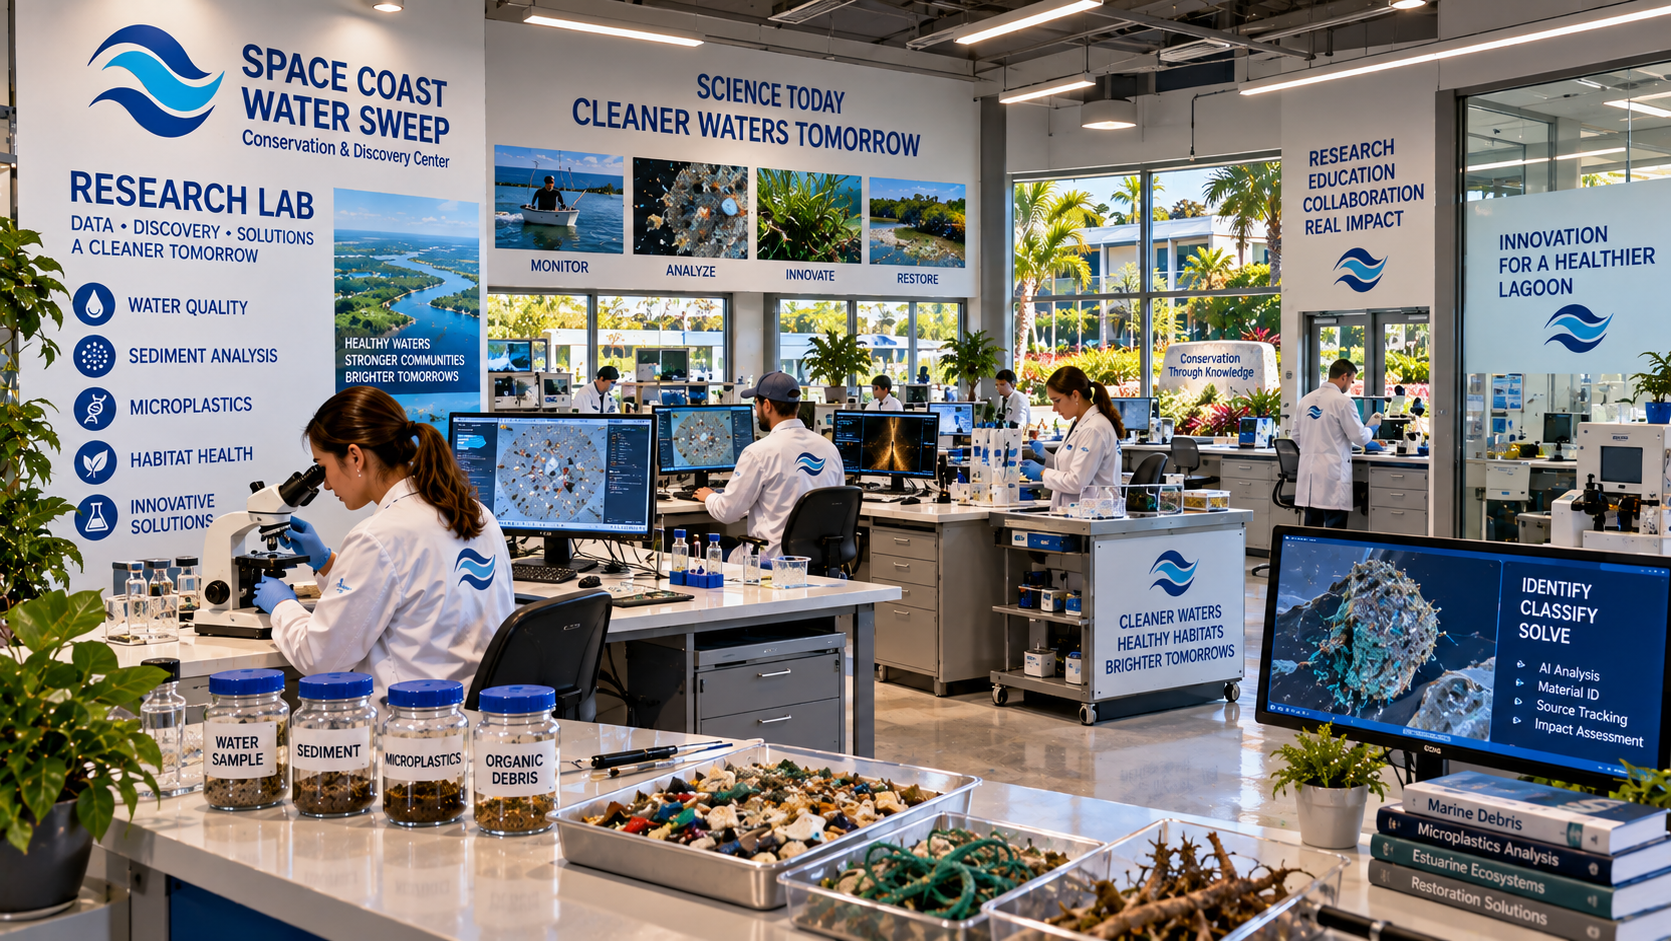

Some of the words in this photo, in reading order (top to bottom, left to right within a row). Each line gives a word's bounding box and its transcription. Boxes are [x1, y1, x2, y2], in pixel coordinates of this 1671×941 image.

[242, 43, 348, 92] SPACE
[357, 65, 447, 108] COAST
[697, 73, 781, 108] SCIENCE
[786, 83, 845, 115] TODAY
[242, 86, 350, 133] WATER
[359, 105, 449, 145] SWEEP
[572, 97, 690, 135] CLEANER
[697, 110, 789, 145] WATERS
[795, 121, 920, 157] TOMORROW
[242, 129, 336, 156] Conservation
[340, 142, 350, 157] &
[354, 144, 410, 167] Discovery
[413, 151, 450, 169] Center
[1309, 138, 1395, 167] RESEARCH
[1308, 163, 1396, 190] EDUCATION
[70, 170, 247, 216] RESEARCH
[259, 188, 314, 220] LAB
[1303, 183, 1425, 213] COLLABORATION
[71, 215, 114, 234] DATA
[134, 220, 221, 240] DISCOVERY
[237, 226, 314, 246] SOLUTIONS
[1305, 216, 1341, 235] REAL
[1346, 210, 1404, 232] IMPACT
[1499, 226, 1608, 251] INNOVATION
[71, 239, 83, 254] A
[89, 240, 164, 260] CLEANER
[169, 244, 259, 263] TOMORROW
[1499, 256, 1531, 274] FOR
[1536, 255, 1549, 271] A
[1555, 247, 1655, 270] HEALTHIER
[531, 258, 589, 274] MONITOR
[665, 263, 716, 278] ANALYZE
[786, 268, 835, 281] INNOVATE
[897, 272, 939, 285] RESTORE
[1499, 278, 1573, 298] LAGOON
[128, 297, 181, 314] WATER
[185, 298, 248, 316] QUALITY
[344, 337, 389, 350] HEALTHY
[392, 338, 431, 350] WATERS
[129, 348, 207, 364] SEDIMENT
[211, 348, 278, 363] ANALYSIS
[344, 354, 398, 367] STRONGER
[401, 354, 465, 366] COMMUNITIES
[1180, 353, 1240, 364] Conservation
[345, 369, 395, 383] BRIGHTER
[397, 370, 459, 382] TOMORROWS
[1168, 366, 1202, 379] Through
[1205, 367, 1254, 380] Knowledge
[130, 396, 252, 415] MICROPLASTICS
[130, 448, 195, 468] HABITAT
[197, 446, 253, 464] HEALTH
[131, 493, 215, 514] INNOVATIVE
[131, 513, 214, 535] SOLUTIONS
[1522, 577, 1592, 600] IDENTIFY
[1119, 610, 1174, 630] CLEANER
[1178, 604, 1222, 622] WATERS
[1520, 600, 1598, 624] CLASSIFY
[1117, 631, 1170, 651] HEALTHY
[1173, 624, 1224, 645] HABITATS
[1519, 623, 1571, 645] SOLVE
[1106, 653, 1162, 674] BRIGHTER
[1165, 644, 1235, 665] TOMORROWS
[1539, 662, 1551, 674] AI
[1554, 664, 1600, 683] Analysis
[1538, 681, 1584, 699] Material
[1587, 688, 1600, 701] ID
[1536, 700, 1576, 717] Source
[1579, 705, 1628, 728] Tracking
[215, 735, 259, 750] WATER
[1535, 718, 1574, 737] Impact
[1576, 725, 1644, 749] Assessment
[212, 753, 264, 767] SAMPLE
[297, 744, 361, 759] SEDIMENT
[385, 752, 462, 768] MICROPLASTICS
[485, 754, 543, 769] ORGANIC
[492, 771, 538, 785] DEBRIS
[1428, 798, 1474, 820] Marine
[1477, 808, 1523, 831] Debris
[1417, 822, 1501, 853] Microplastics
[1504, 842, 1559, 867] Analysis
[1412, 848, 1468, 875] Estuarine
[1471, 862, 1546, 895] Ecosystems
[1411, 876, 1481, 907] Restoration
[1484, 896, 1548, 926] Solutions
